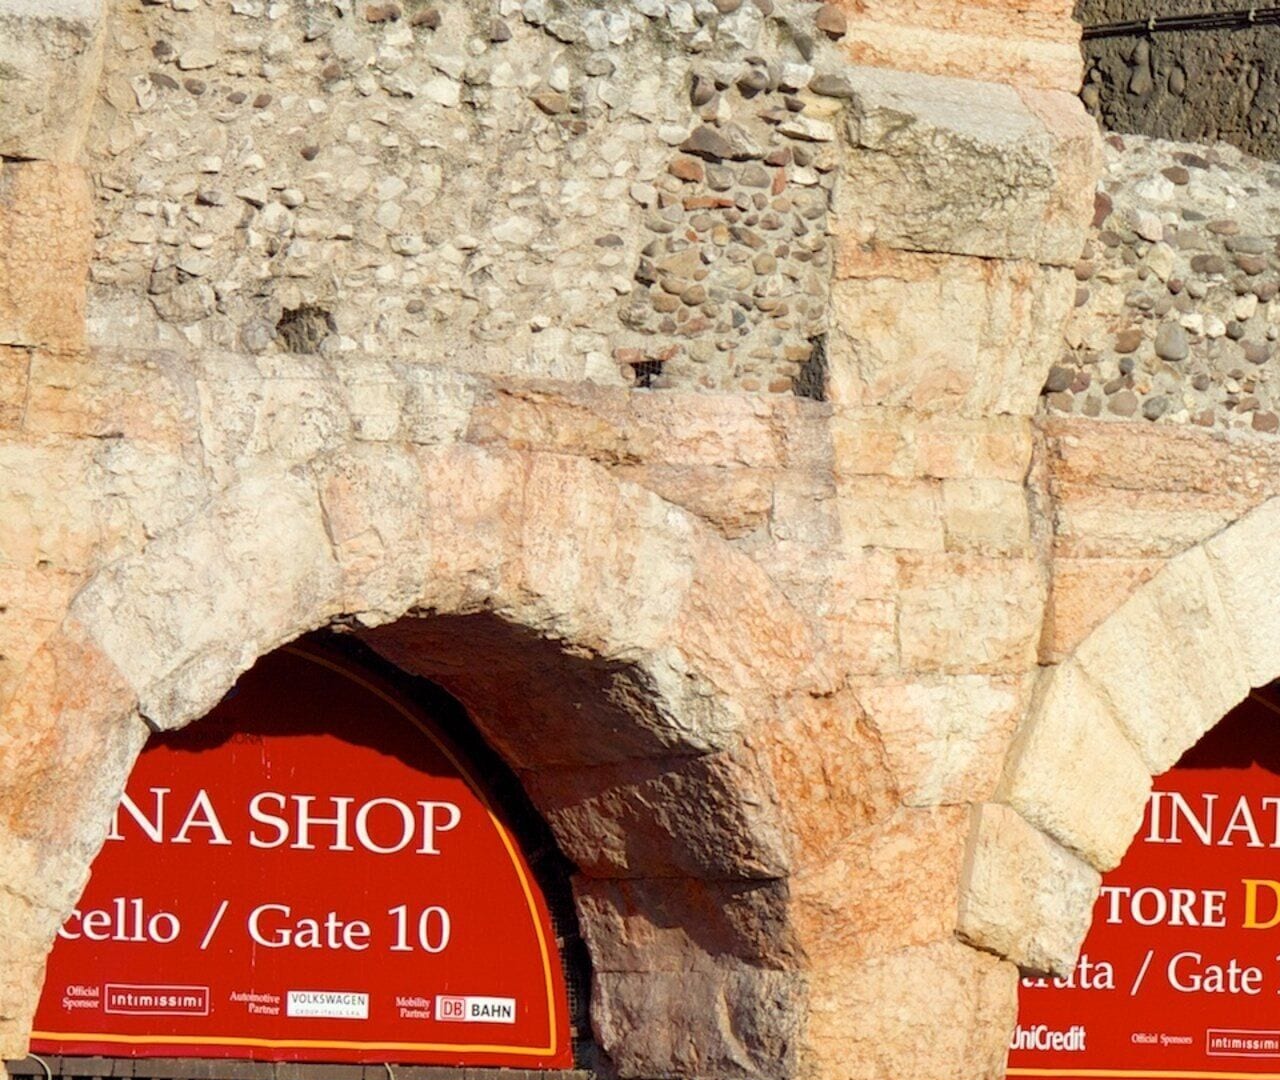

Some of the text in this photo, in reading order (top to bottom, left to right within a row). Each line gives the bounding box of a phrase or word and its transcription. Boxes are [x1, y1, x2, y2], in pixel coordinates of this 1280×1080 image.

[248, 791, 463, 855] SHOP
[248, 903, 372, 951] Gate
[388, 904, 452, 953] 10
[1166, 951, 1263, 996] Gate
[112, 993, 203, 1008] intimissimi
[291, 993, 366, 1006] VOLKSWAGEN
[443, 1000, 512, 1018] DB BAHN
[1211, 1037, 1279, 1050] intimissimi
